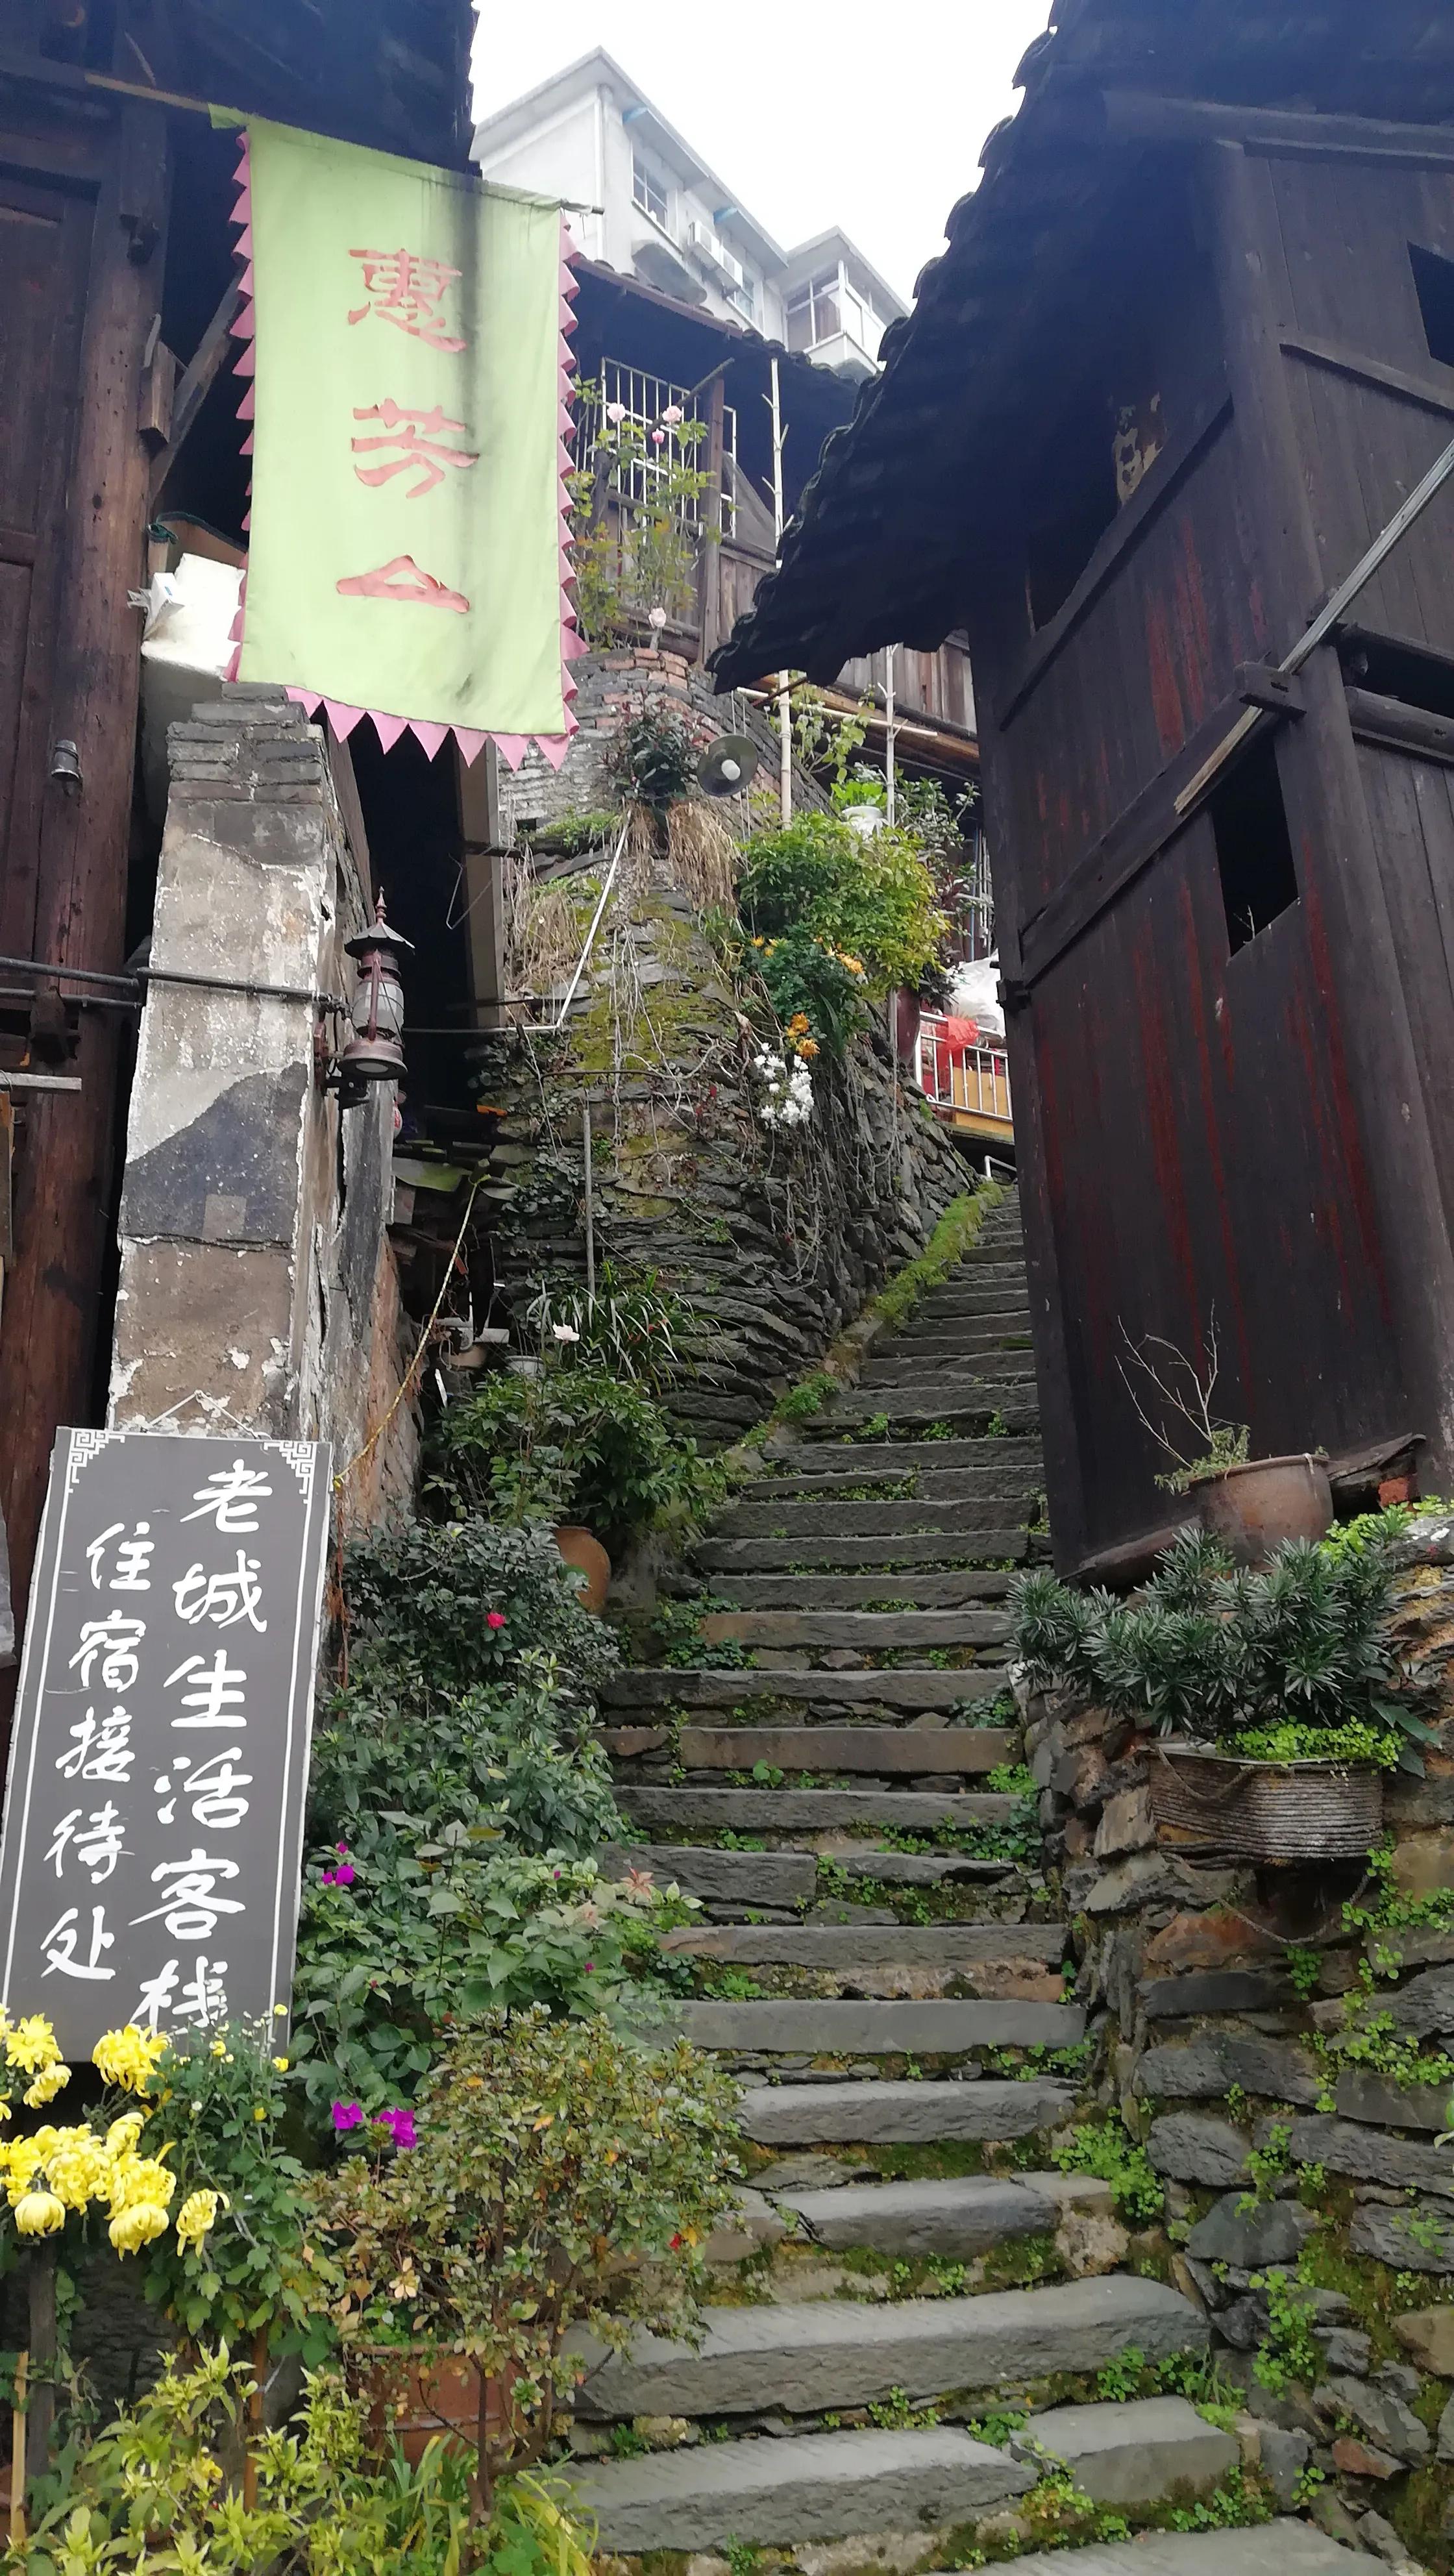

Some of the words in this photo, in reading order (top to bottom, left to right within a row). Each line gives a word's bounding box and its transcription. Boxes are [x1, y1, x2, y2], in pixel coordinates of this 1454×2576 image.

[40, 1520, 156, 1981] 住宿接待处
[129, 1459, 273, 2037] 老城生活客栈
